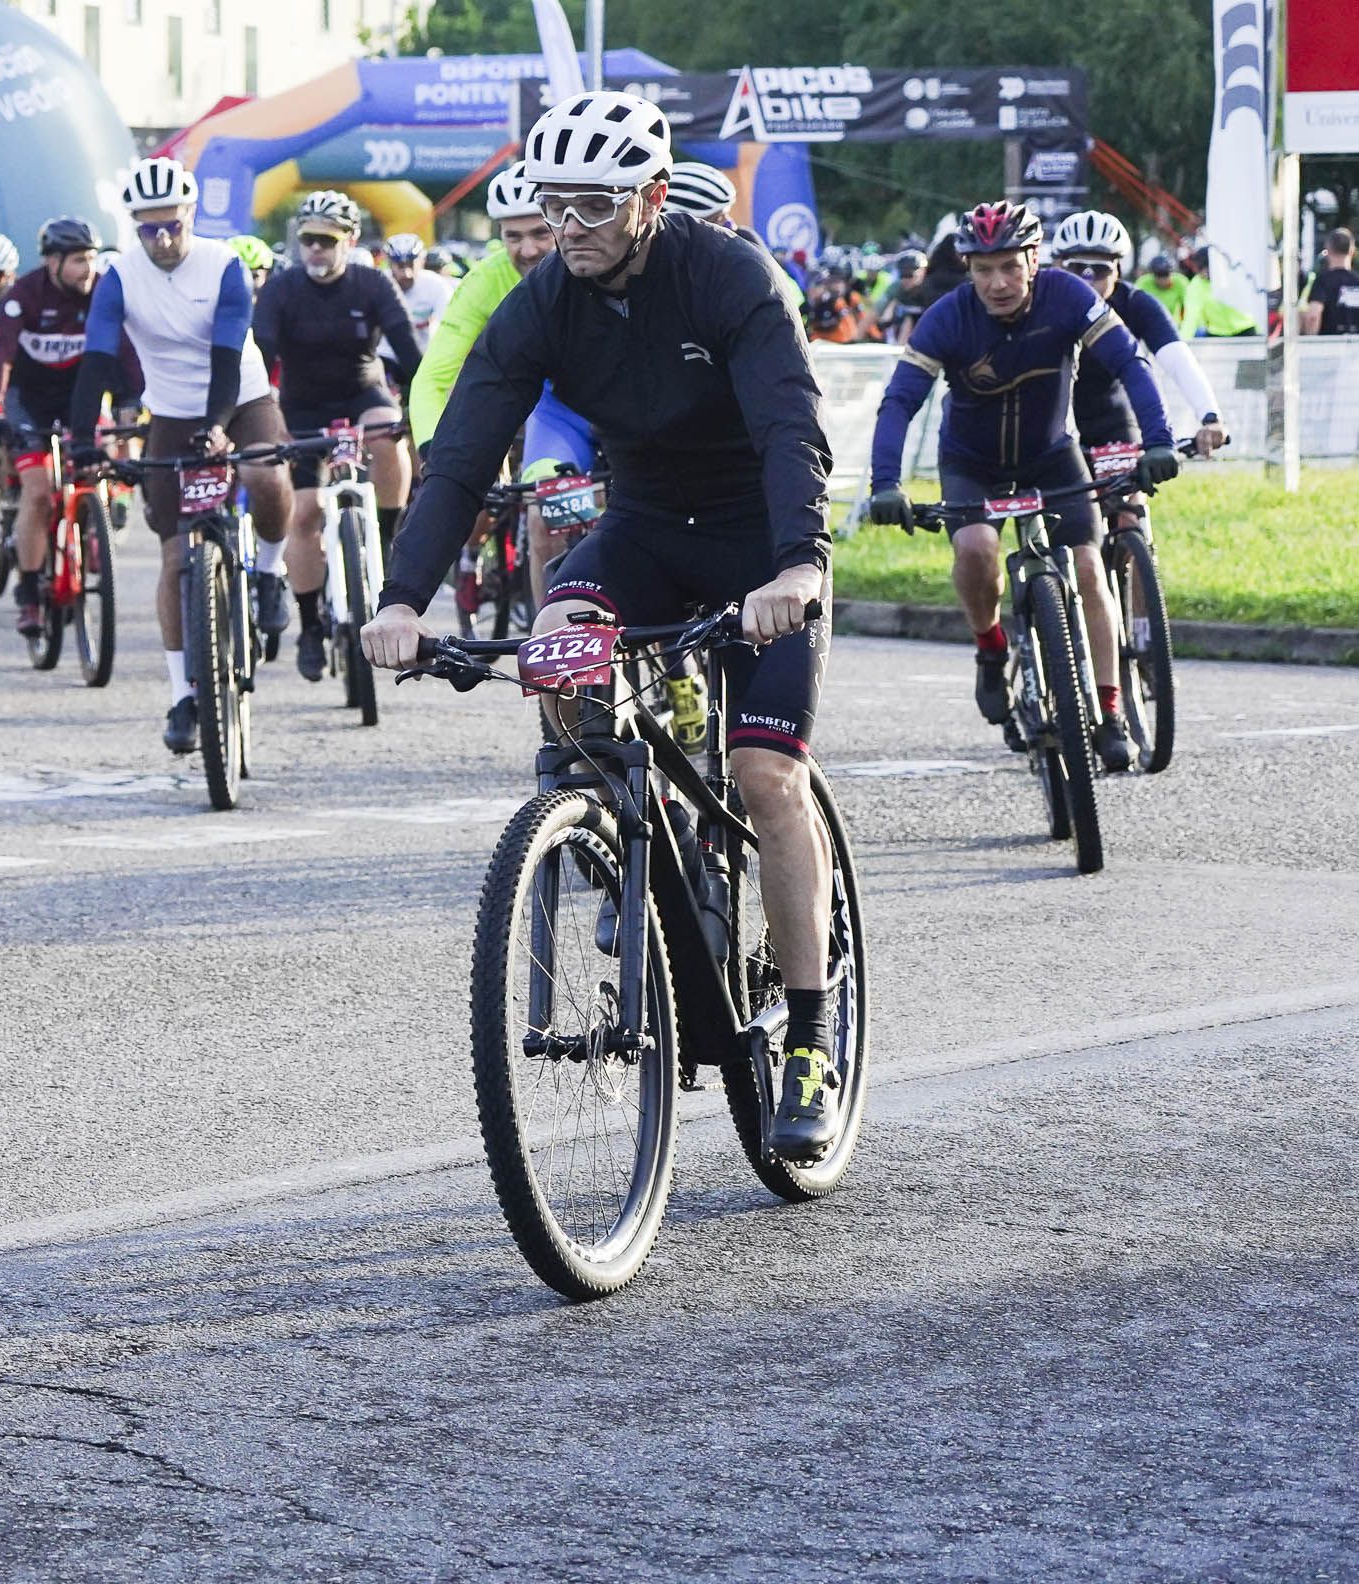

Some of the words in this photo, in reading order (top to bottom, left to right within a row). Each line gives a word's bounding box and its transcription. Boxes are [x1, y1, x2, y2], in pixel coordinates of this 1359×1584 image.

[760, 94, 862, 121] bike
[526, 637, 603, 664] 2124
[739, 712, 799, 732] XOSBERT
